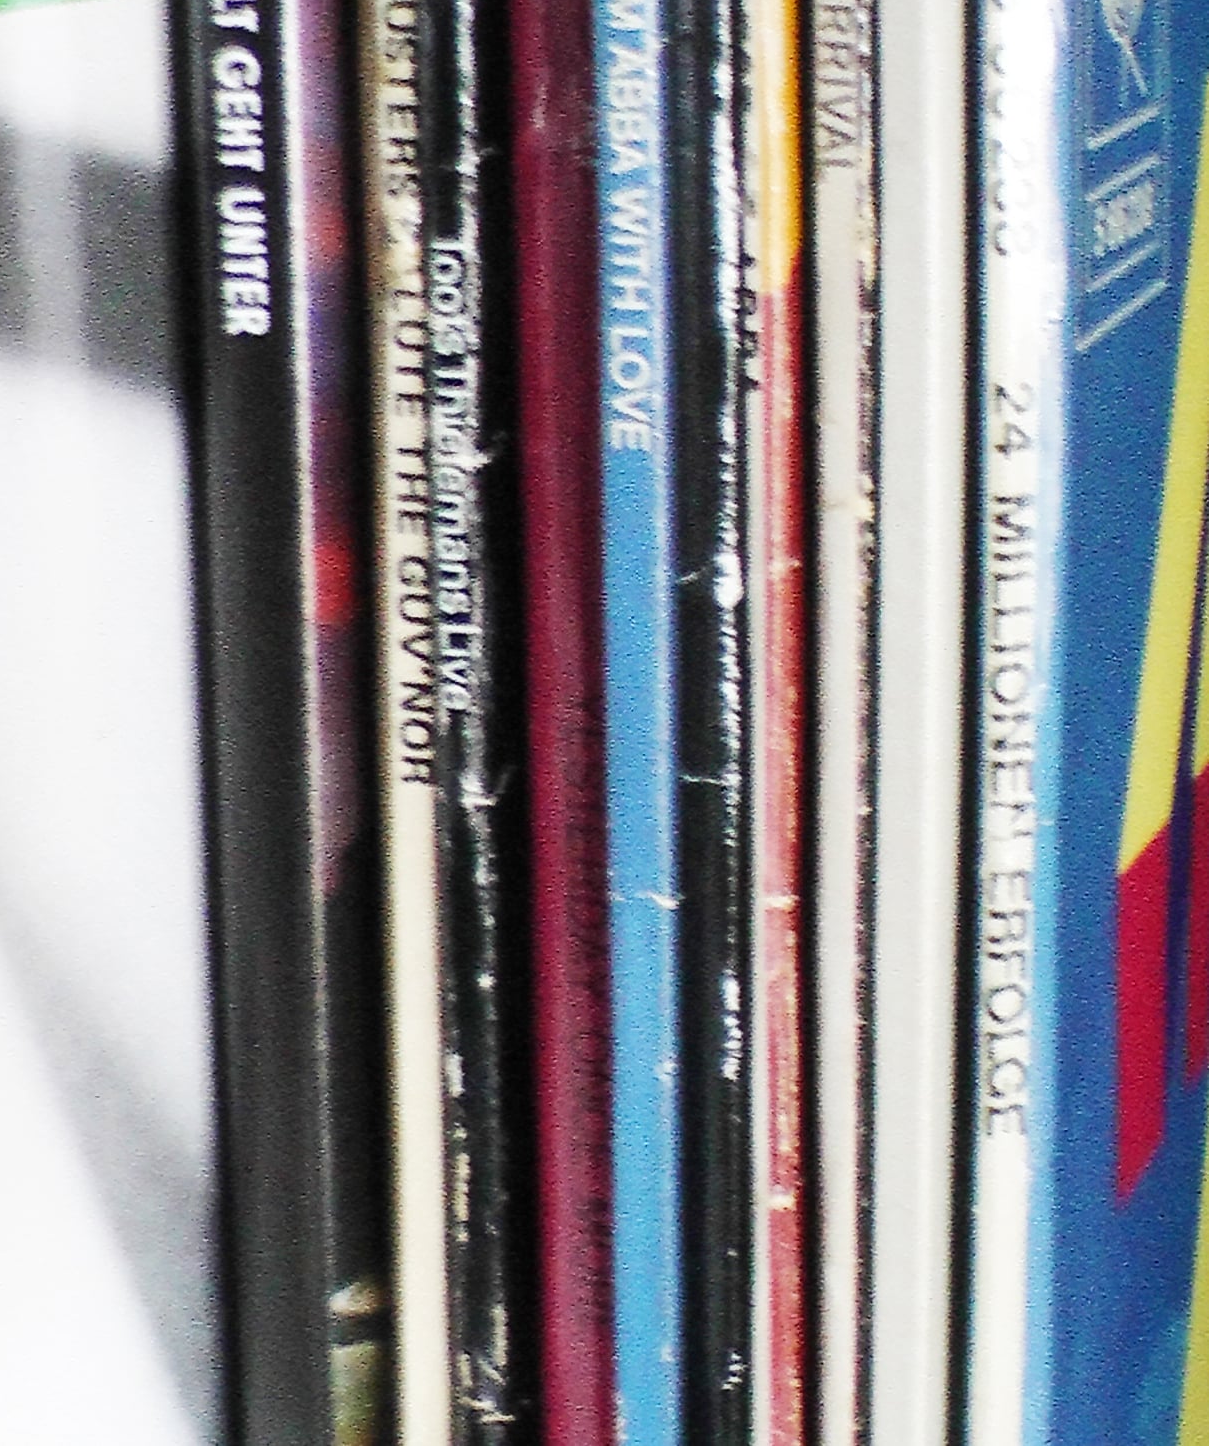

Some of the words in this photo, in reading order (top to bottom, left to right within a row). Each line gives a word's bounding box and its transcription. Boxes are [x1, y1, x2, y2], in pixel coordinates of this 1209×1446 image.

[211, 44, 266, 172] GEHT
[608, 43, 656, 175] ABBA
[219, 183, 274, 337] UNTER
[607, 184, 654, 310] WITH
[609, 325, 656, 453] LOVE
[993, 381, 1033, 460] 24
[391, 438, 435, 537] THE
[396, 554, 439, 787] GUV'NOR
[988, 494, 1034, 841] MILLIONEN
[984, 871, 1032, 1139] ERFOLGE
